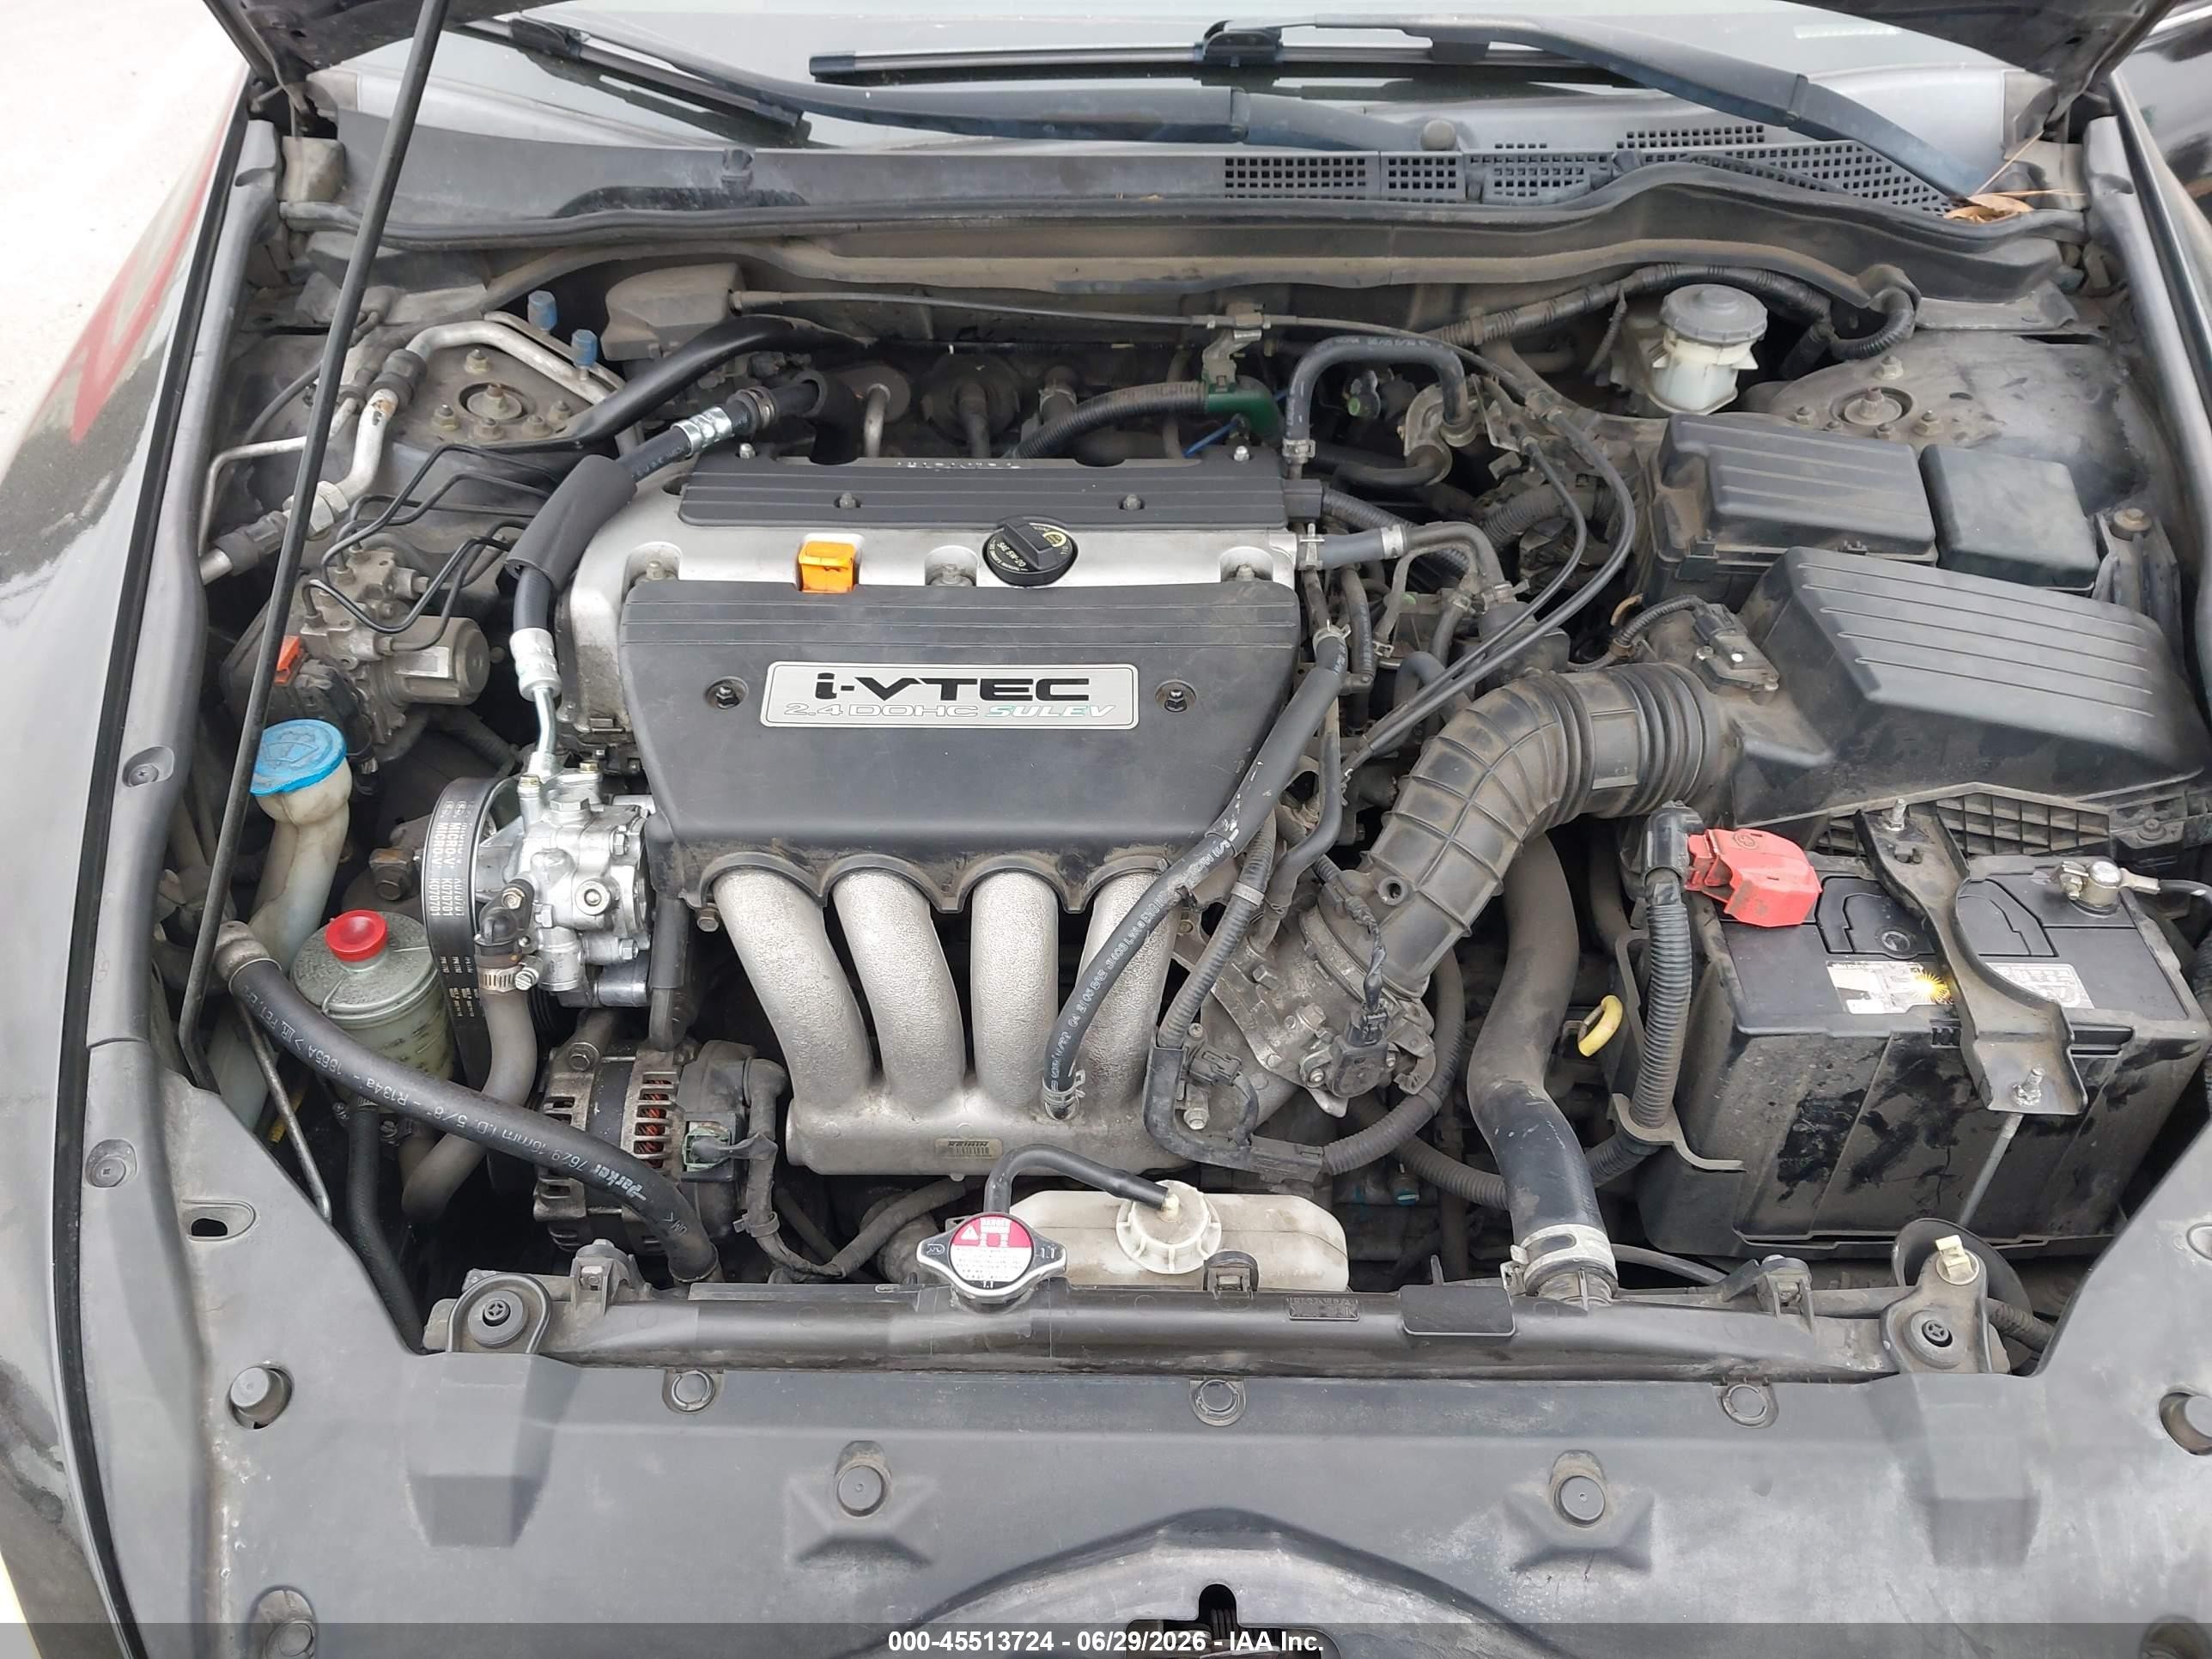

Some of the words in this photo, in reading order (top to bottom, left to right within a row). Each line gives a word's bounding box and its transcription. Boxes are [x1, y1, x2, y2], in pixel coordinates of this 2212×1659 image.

[997, 542, 1010, 553] SAE
[1006, 549, 1026, 567] 5W-20
[815, 672, 1089, 702] i-VTEC
[784, 702, 843, 717] 2.4
[848, 703, 978, 718] DOHC
[985, 704, 1116, 718] SULEV
[429, 878, 441, 916] K070701
[441, 878, 453, 916] K070701
[366, 1078, 409, 1106] R134a
[592, 1164, 646, 1200] Parker
